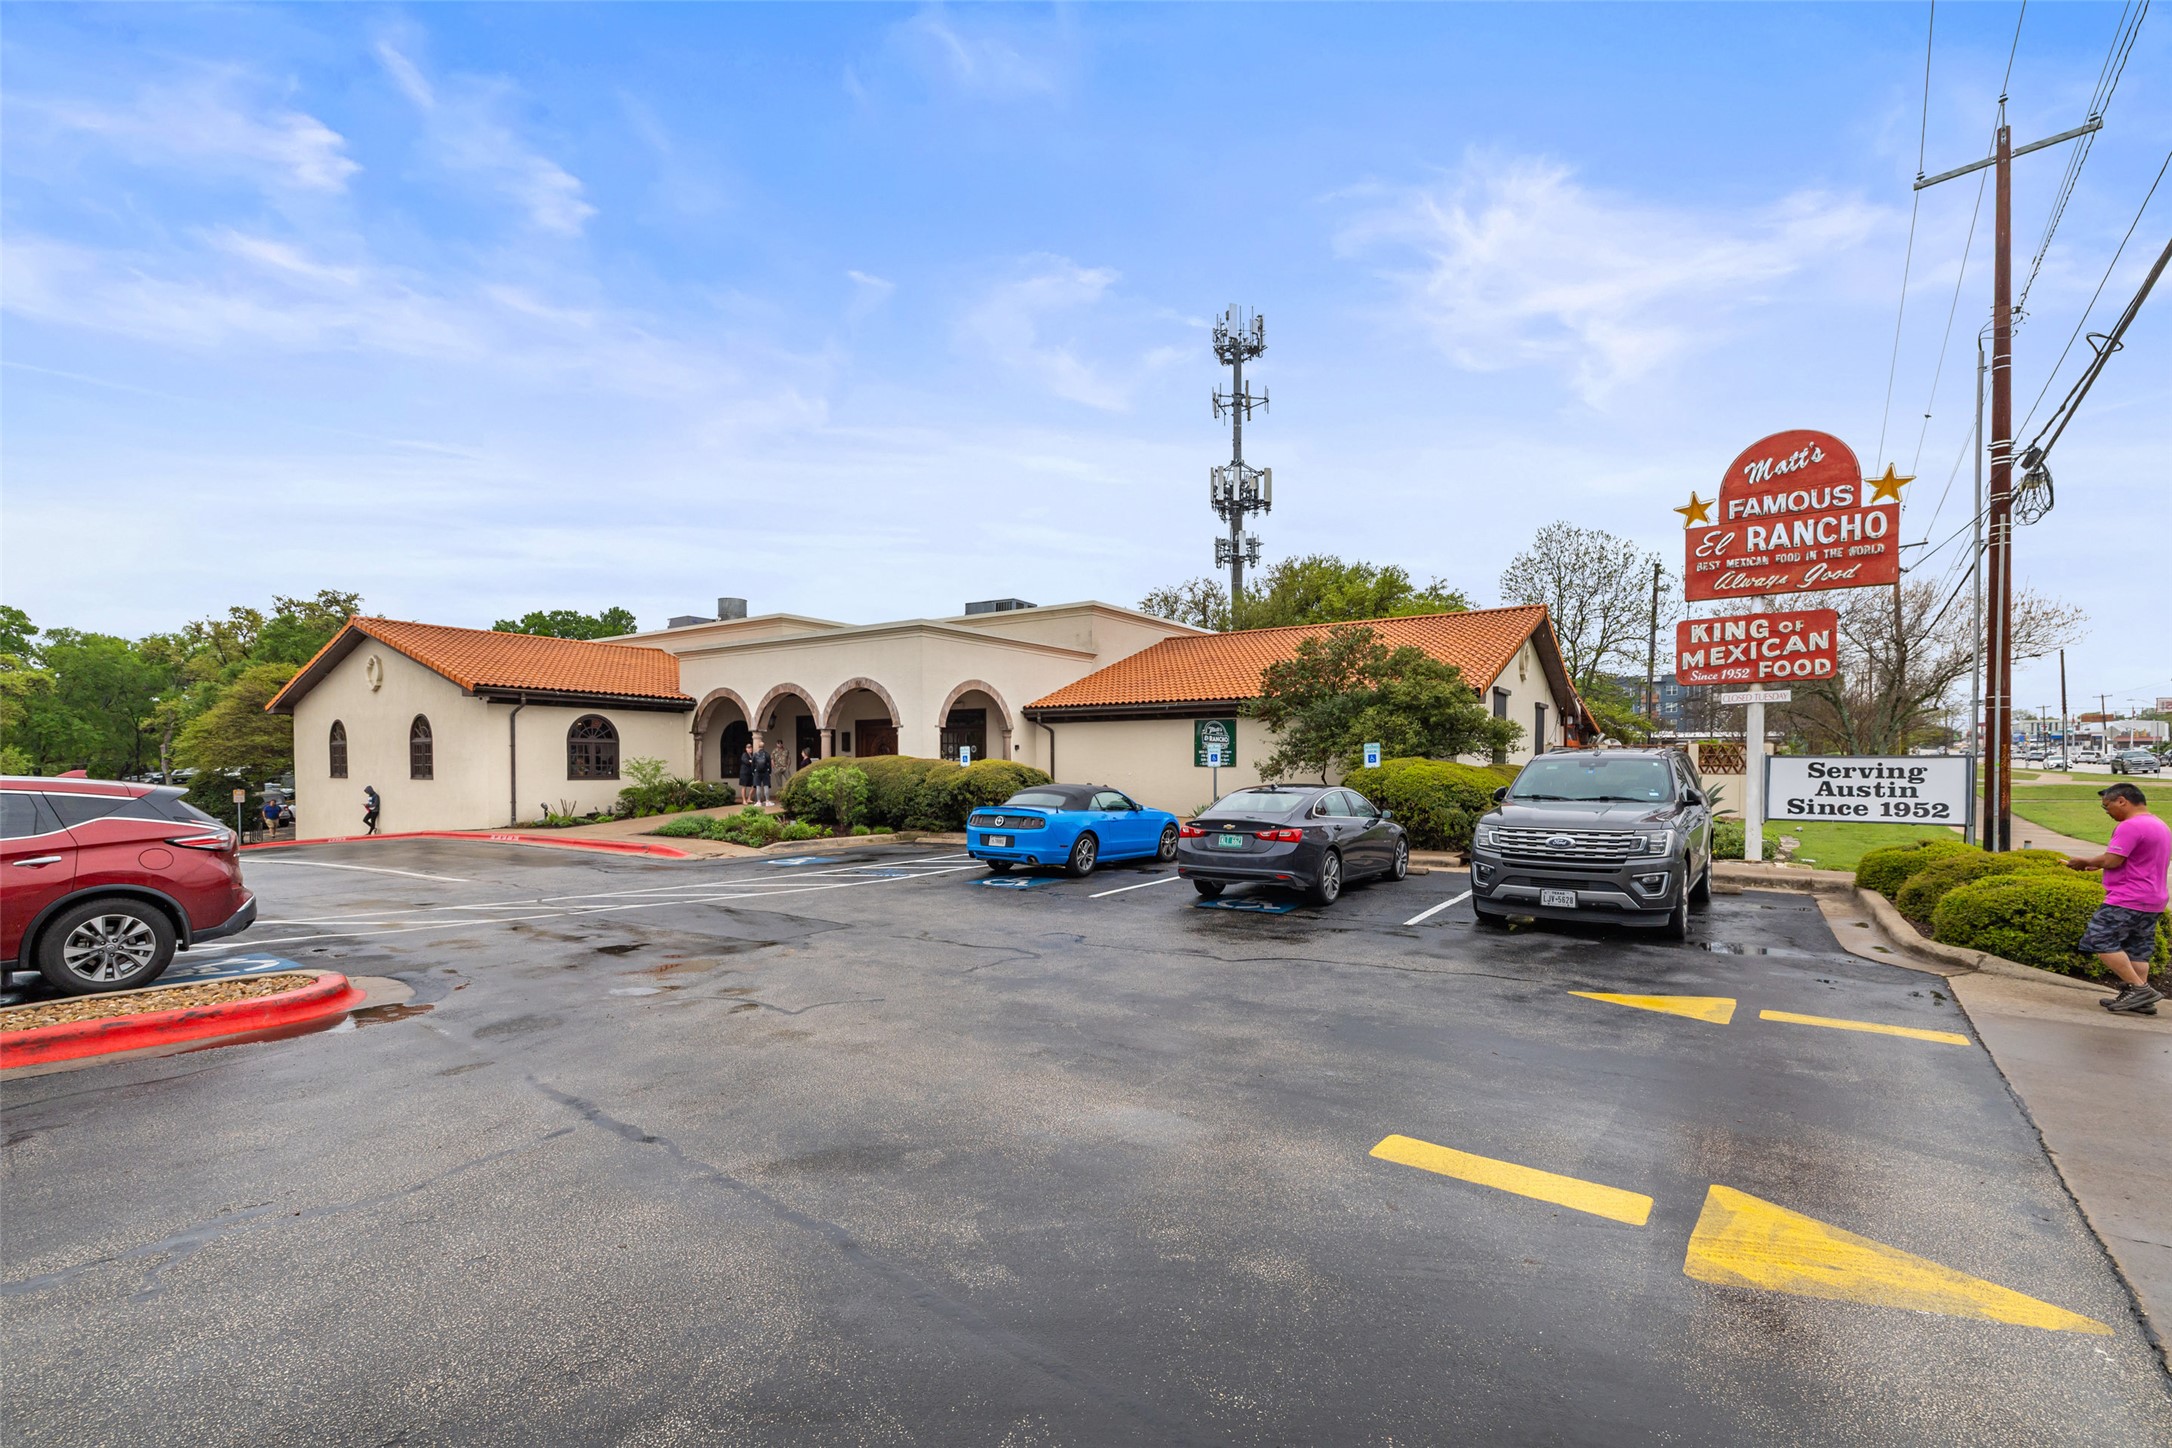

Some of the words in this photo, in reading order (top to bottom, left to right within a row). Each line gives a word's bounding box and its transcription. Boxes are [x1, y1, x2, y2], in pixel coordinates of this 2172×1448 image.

[1743, 441, 1825, 484] Matt's
[1728, 484, 1855, 520] FAMOUS
[1695, 530, 1735, 557] El
[1746, 511, 1888, 552] RANCHO
[1696, 560, 1721, 572] BEST
[1726, 556, 1769, 568] MEXICAN
[1775, 553, 1801, 563] FOOD
[1806, 551, 1817, 561] IN
[1823, 547, 1843, 559] THE
[1848, 544, 1885, 557] WORLD
[1713, 570, 1789, 590] Always
[1796, 562, 1863, 588] Good
[1690, 618, 1769, 643] KING
[1778, 620, 1804, 633] OF
[1682, 630, 1831, 670] MEXICAN
[1690, 670, 1718, 681] Since
[1721, 668, 1750, 679] 1952
[1759, 658, 1831, 678] FOOD
[1723, 693, 1753, 703] CLOSED
[1753, 692, 1789, 702] TUESDAY
[1807, 762, 1928, 784] Serving
[1814, 781, 1919, 799] Austin
[1787, 798, 1869, 815] Since
[1880, 802, 1950, 819] 1952
